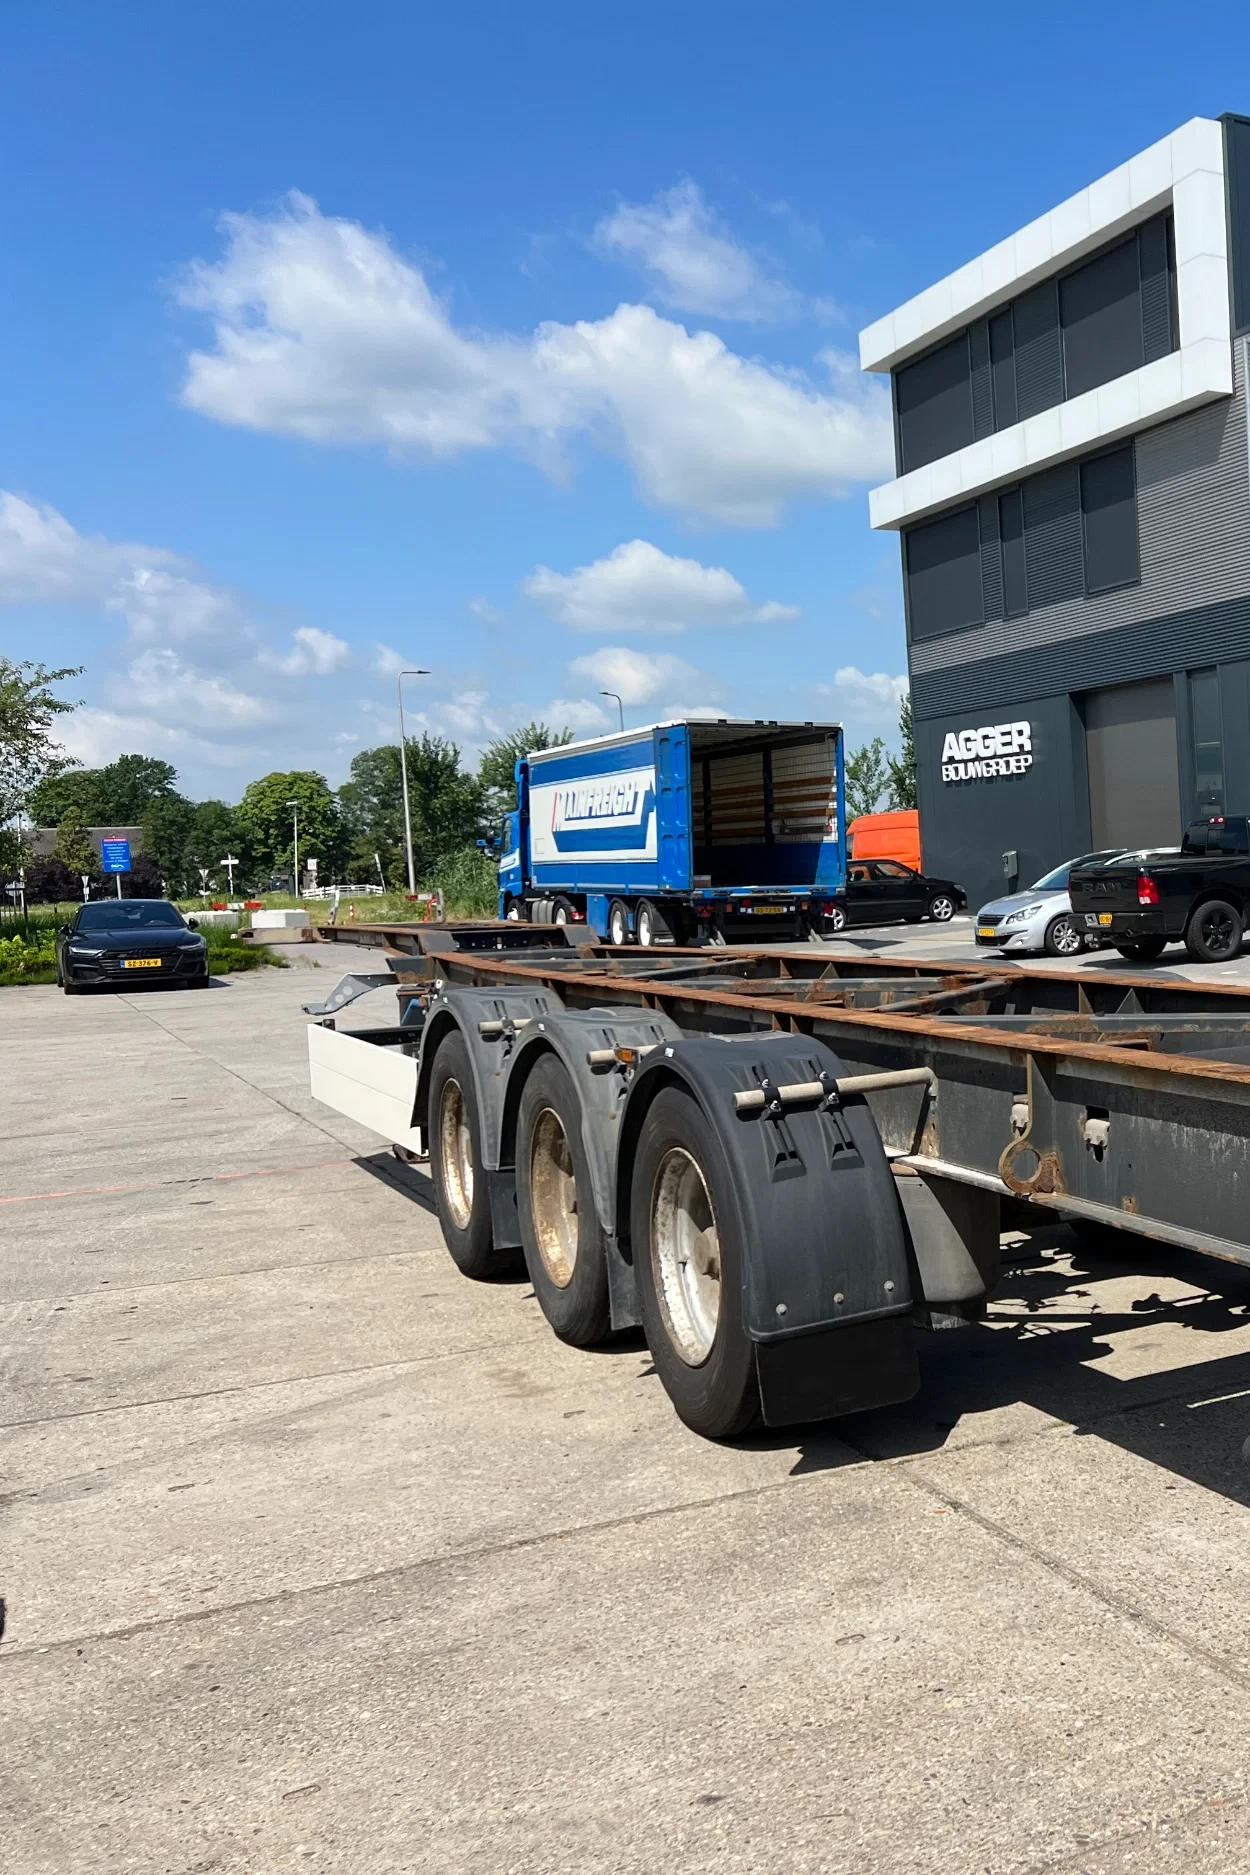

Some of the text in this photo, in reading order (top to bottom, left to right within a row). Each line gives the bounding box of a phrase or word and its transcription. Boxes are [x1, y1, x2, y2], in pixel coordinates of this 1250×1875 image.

[942, 720, 1032, 763] AGGER
[942, 754, 1033, 782] BOUWGROEP
[552, 780, 651, 832] MAINFREIGHT
